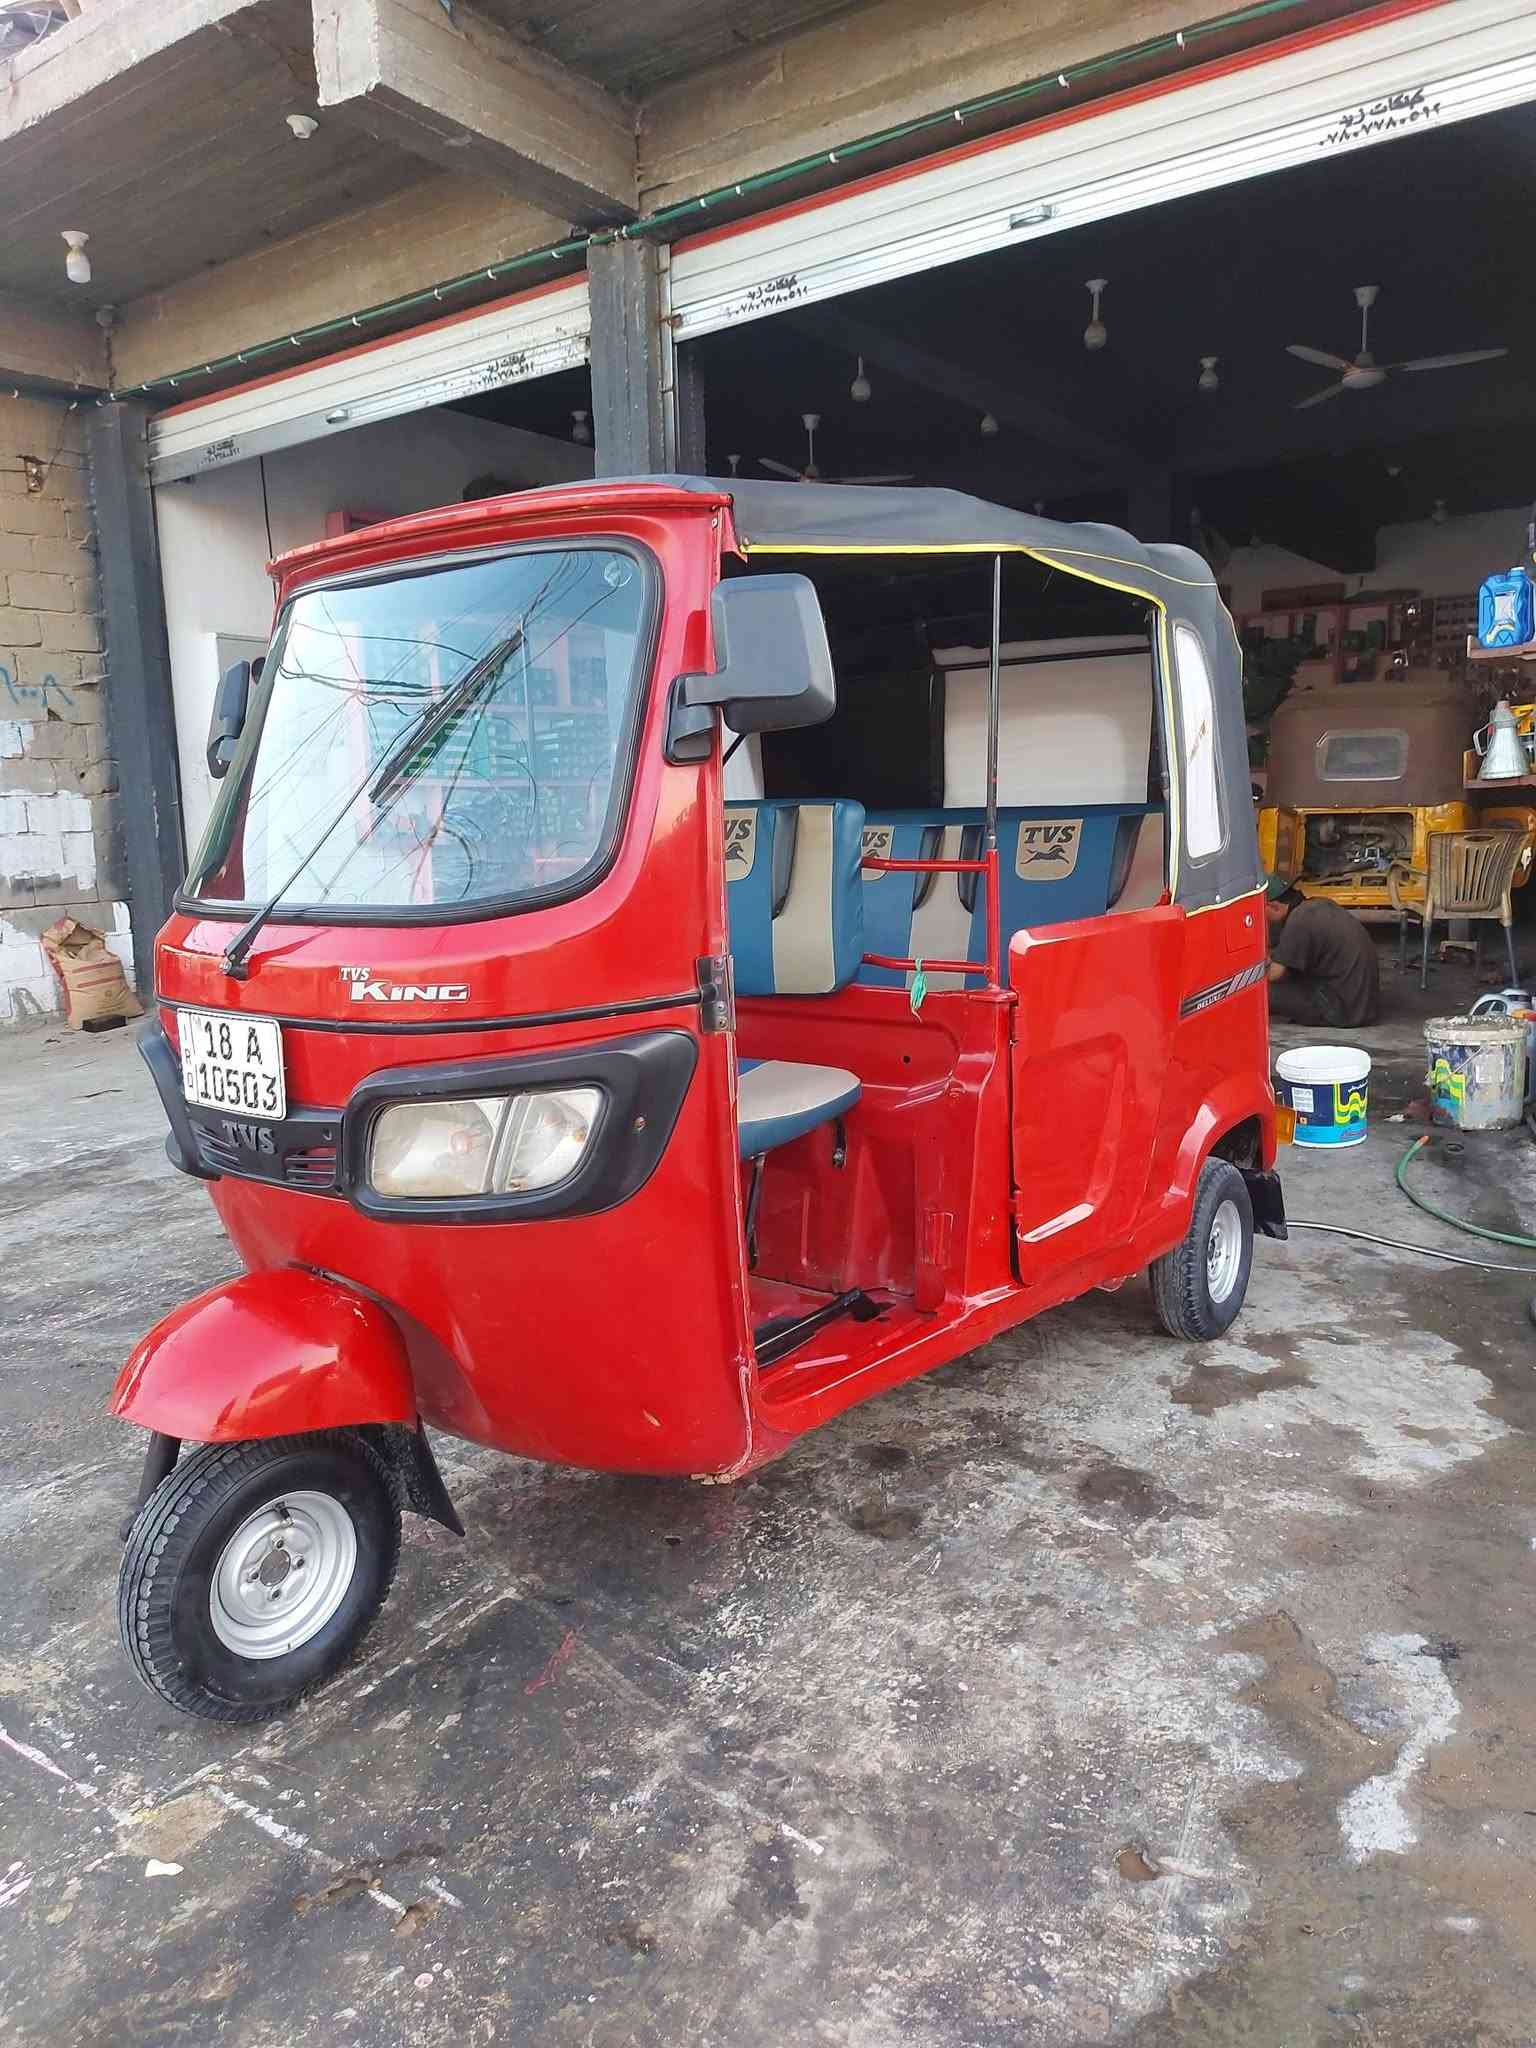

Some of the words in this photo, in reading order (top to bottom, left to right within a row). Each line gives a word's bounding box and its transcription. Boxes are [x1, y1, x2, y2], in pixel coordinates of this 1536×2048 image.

[723, 818, 753, 841] VS
[861, 831, 889, 849] VS
[1023, 825, 1076, 844] TVS
[340, 967, 371, 981] TVS
[204, 1020, 233, 1061] 18
[246, 1025, 263, 1065] A
[199, 1062, 277, 1111] 10503
[221, 1119, 277, 1155] TVS
